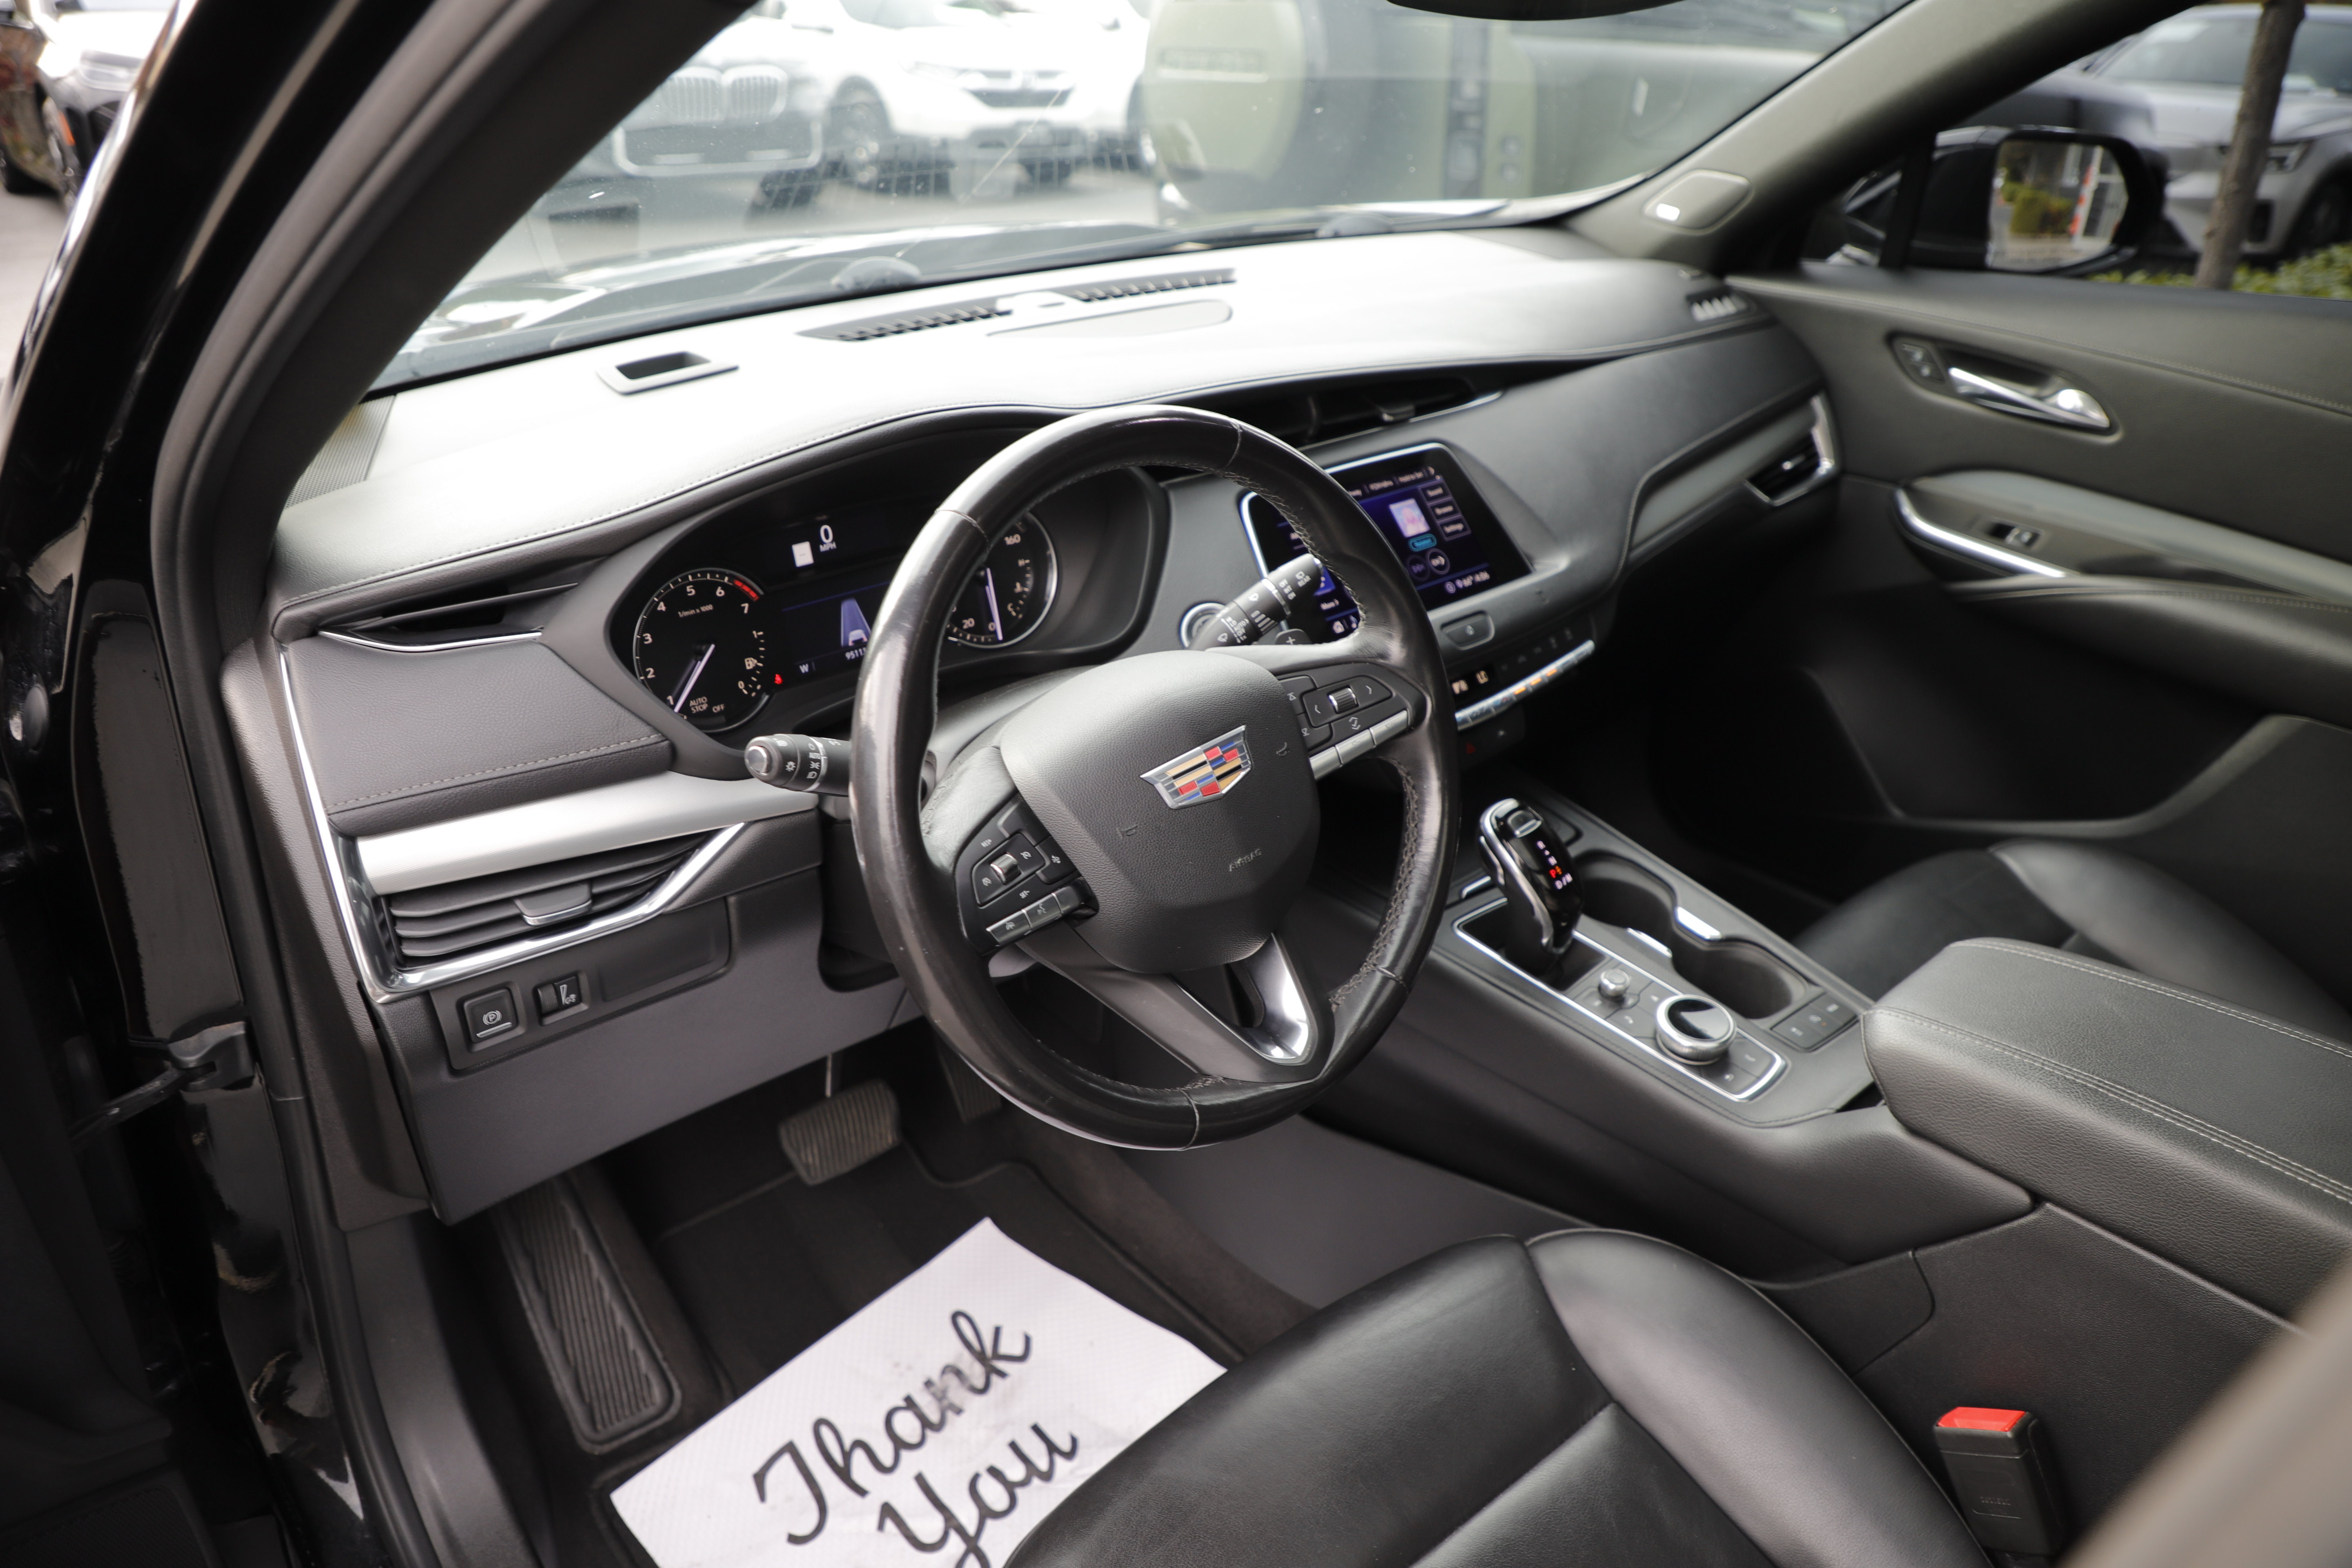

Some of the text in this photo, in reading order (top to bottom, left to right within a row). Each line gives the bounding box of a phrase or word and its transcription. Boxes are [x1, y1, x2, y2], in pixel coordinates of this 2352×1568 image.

[820, 524, 833, 543] 0
[1004, 534, 1021, 545] 160
[820, 541, 837, 552] MPH
[686, 585, 695, 596] 5
[716, 586, 725, 597] 6
[657, 601, 666, 611] 4
[741, 603, 749, 614] 7
[643, 633, 653, 644] 3
[646, 667, 655, 678] 2
[799, 663, 809, 673] W
[738, 681, 745, 689] 0
[667, 695, 674, 705] 1
[690, 696, 708, 706] AUTO
[691, 703, 708, 713] STOP
[712, 704, 725, 713] OFF
[1229, 849, 1262, 872] AIRBAG
[753, 1310, 1031, 1546] Thank
[877, 1423, 1078, 1568] You
